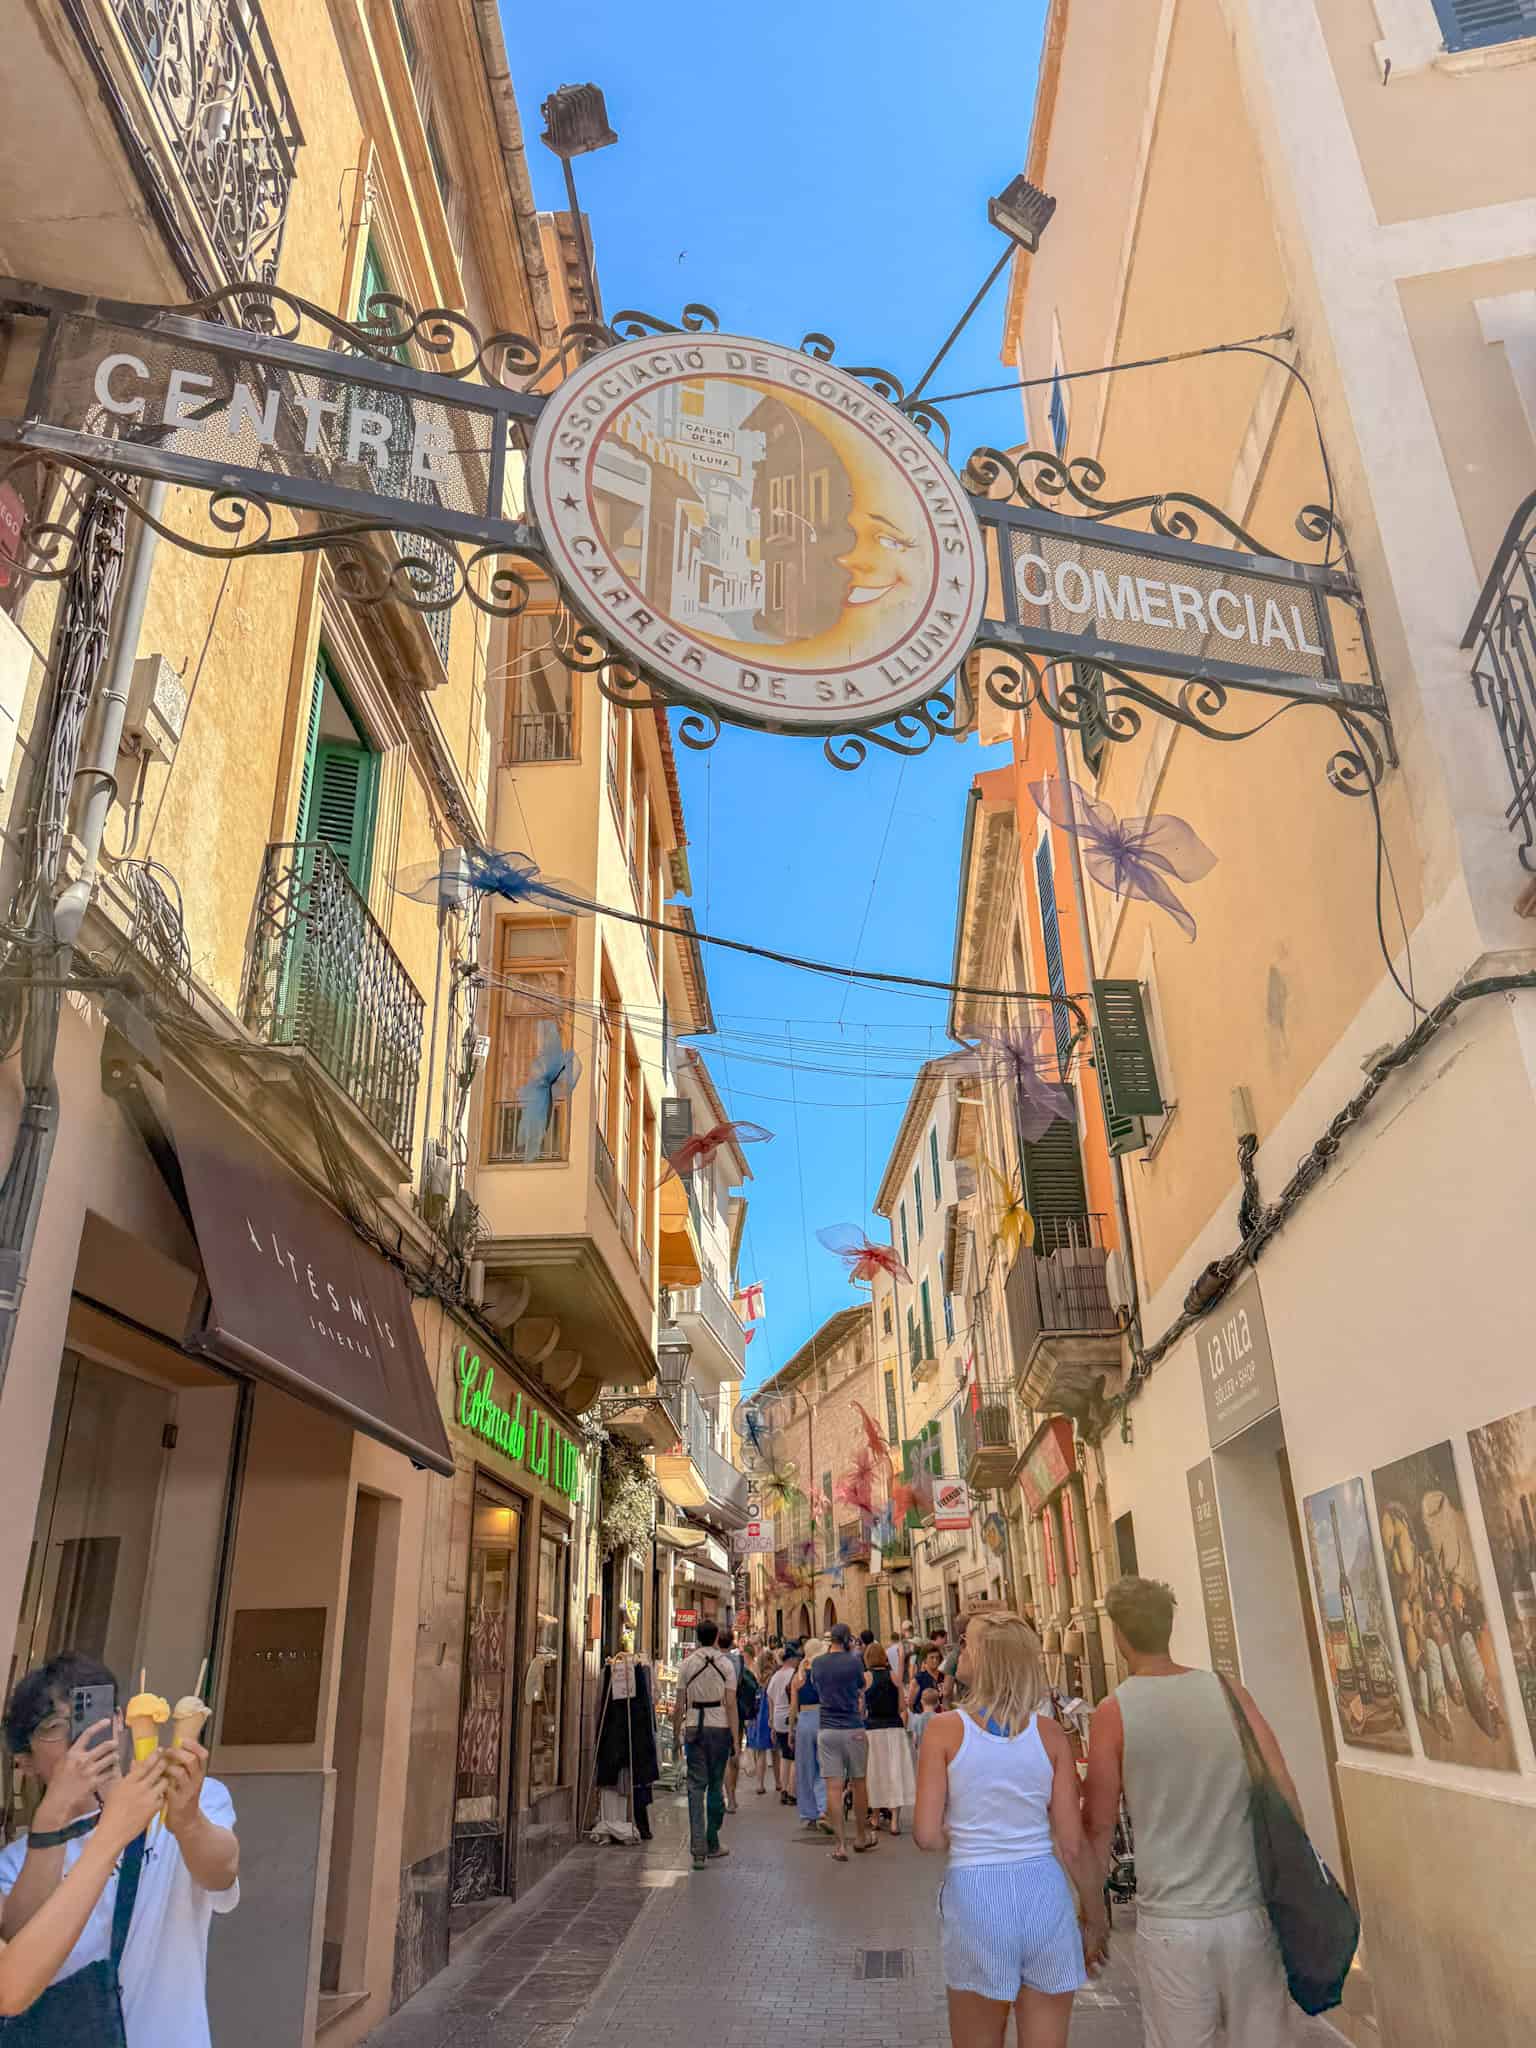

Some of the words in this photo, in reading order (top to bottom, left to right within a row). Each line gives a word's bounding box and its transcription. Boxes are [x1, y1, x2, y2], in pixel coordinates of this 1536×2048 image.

[94, 353, 453, 481] CENTRE
[555, 347, 706, 475] ASSOCIACIÓ
[726, 351, 769, 375] DE
[790, 368, 965, 556] COMERCIANTS
[571, 535, 707, 673] CARRER
[737, 671, 788, 700] DE
[815, 680, 865, 703] SA
[877, 610, 960, 687] LLUNA
[1014, 552, 1326, 657] COMERCIAL
